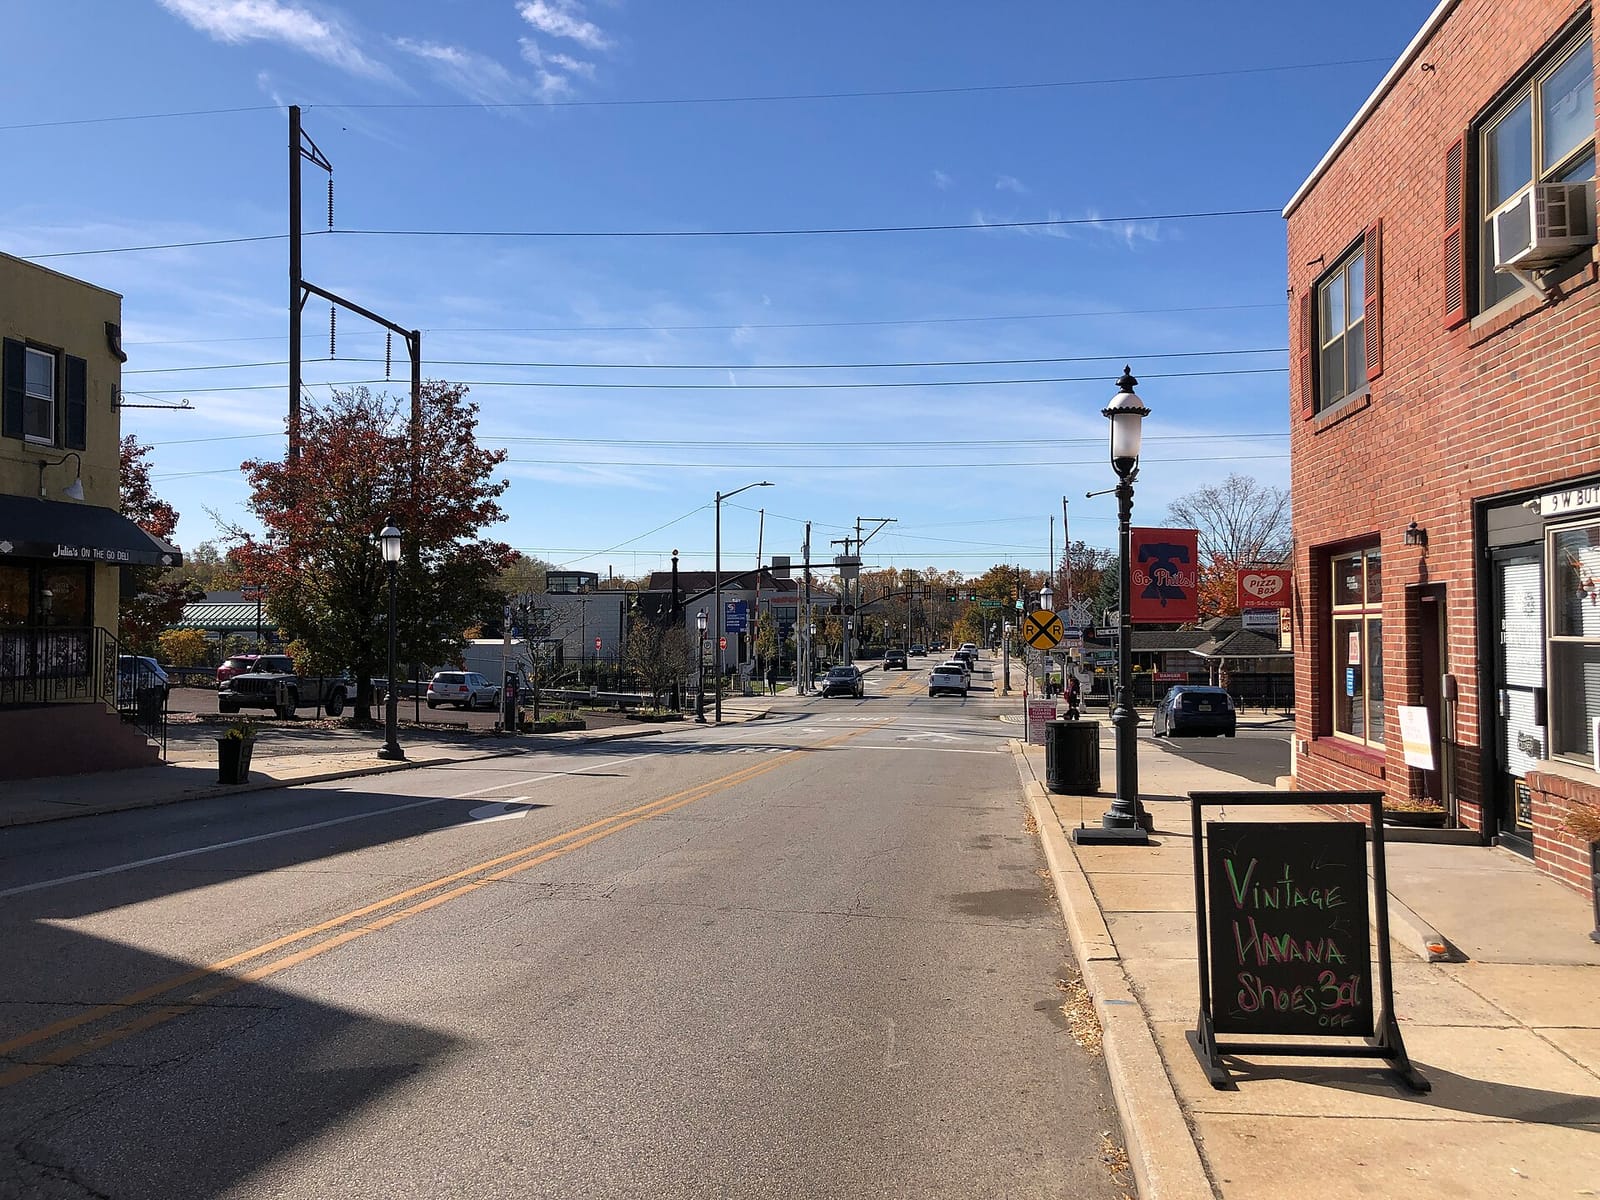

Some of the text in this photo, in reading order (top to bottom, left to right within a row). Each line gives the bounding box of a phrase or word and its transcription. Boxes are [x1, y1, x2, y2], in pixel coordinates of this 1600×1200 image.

[1552, 496, 1558, 512] 9
[1561, 491, 1572, 508] W
[52, 544, 129, 561] Julia's ON THE GO DELI
[1132, 570, 1152, 586] Go
[1250, 579, 1276, 588] PIZZA
[1026, 625, 1034, 635] R
[1053, 625, 1061, 635] R
[1232, 916, 1347, 967] HAVANA
[1318, 1016, 1356, 1028] OFF
